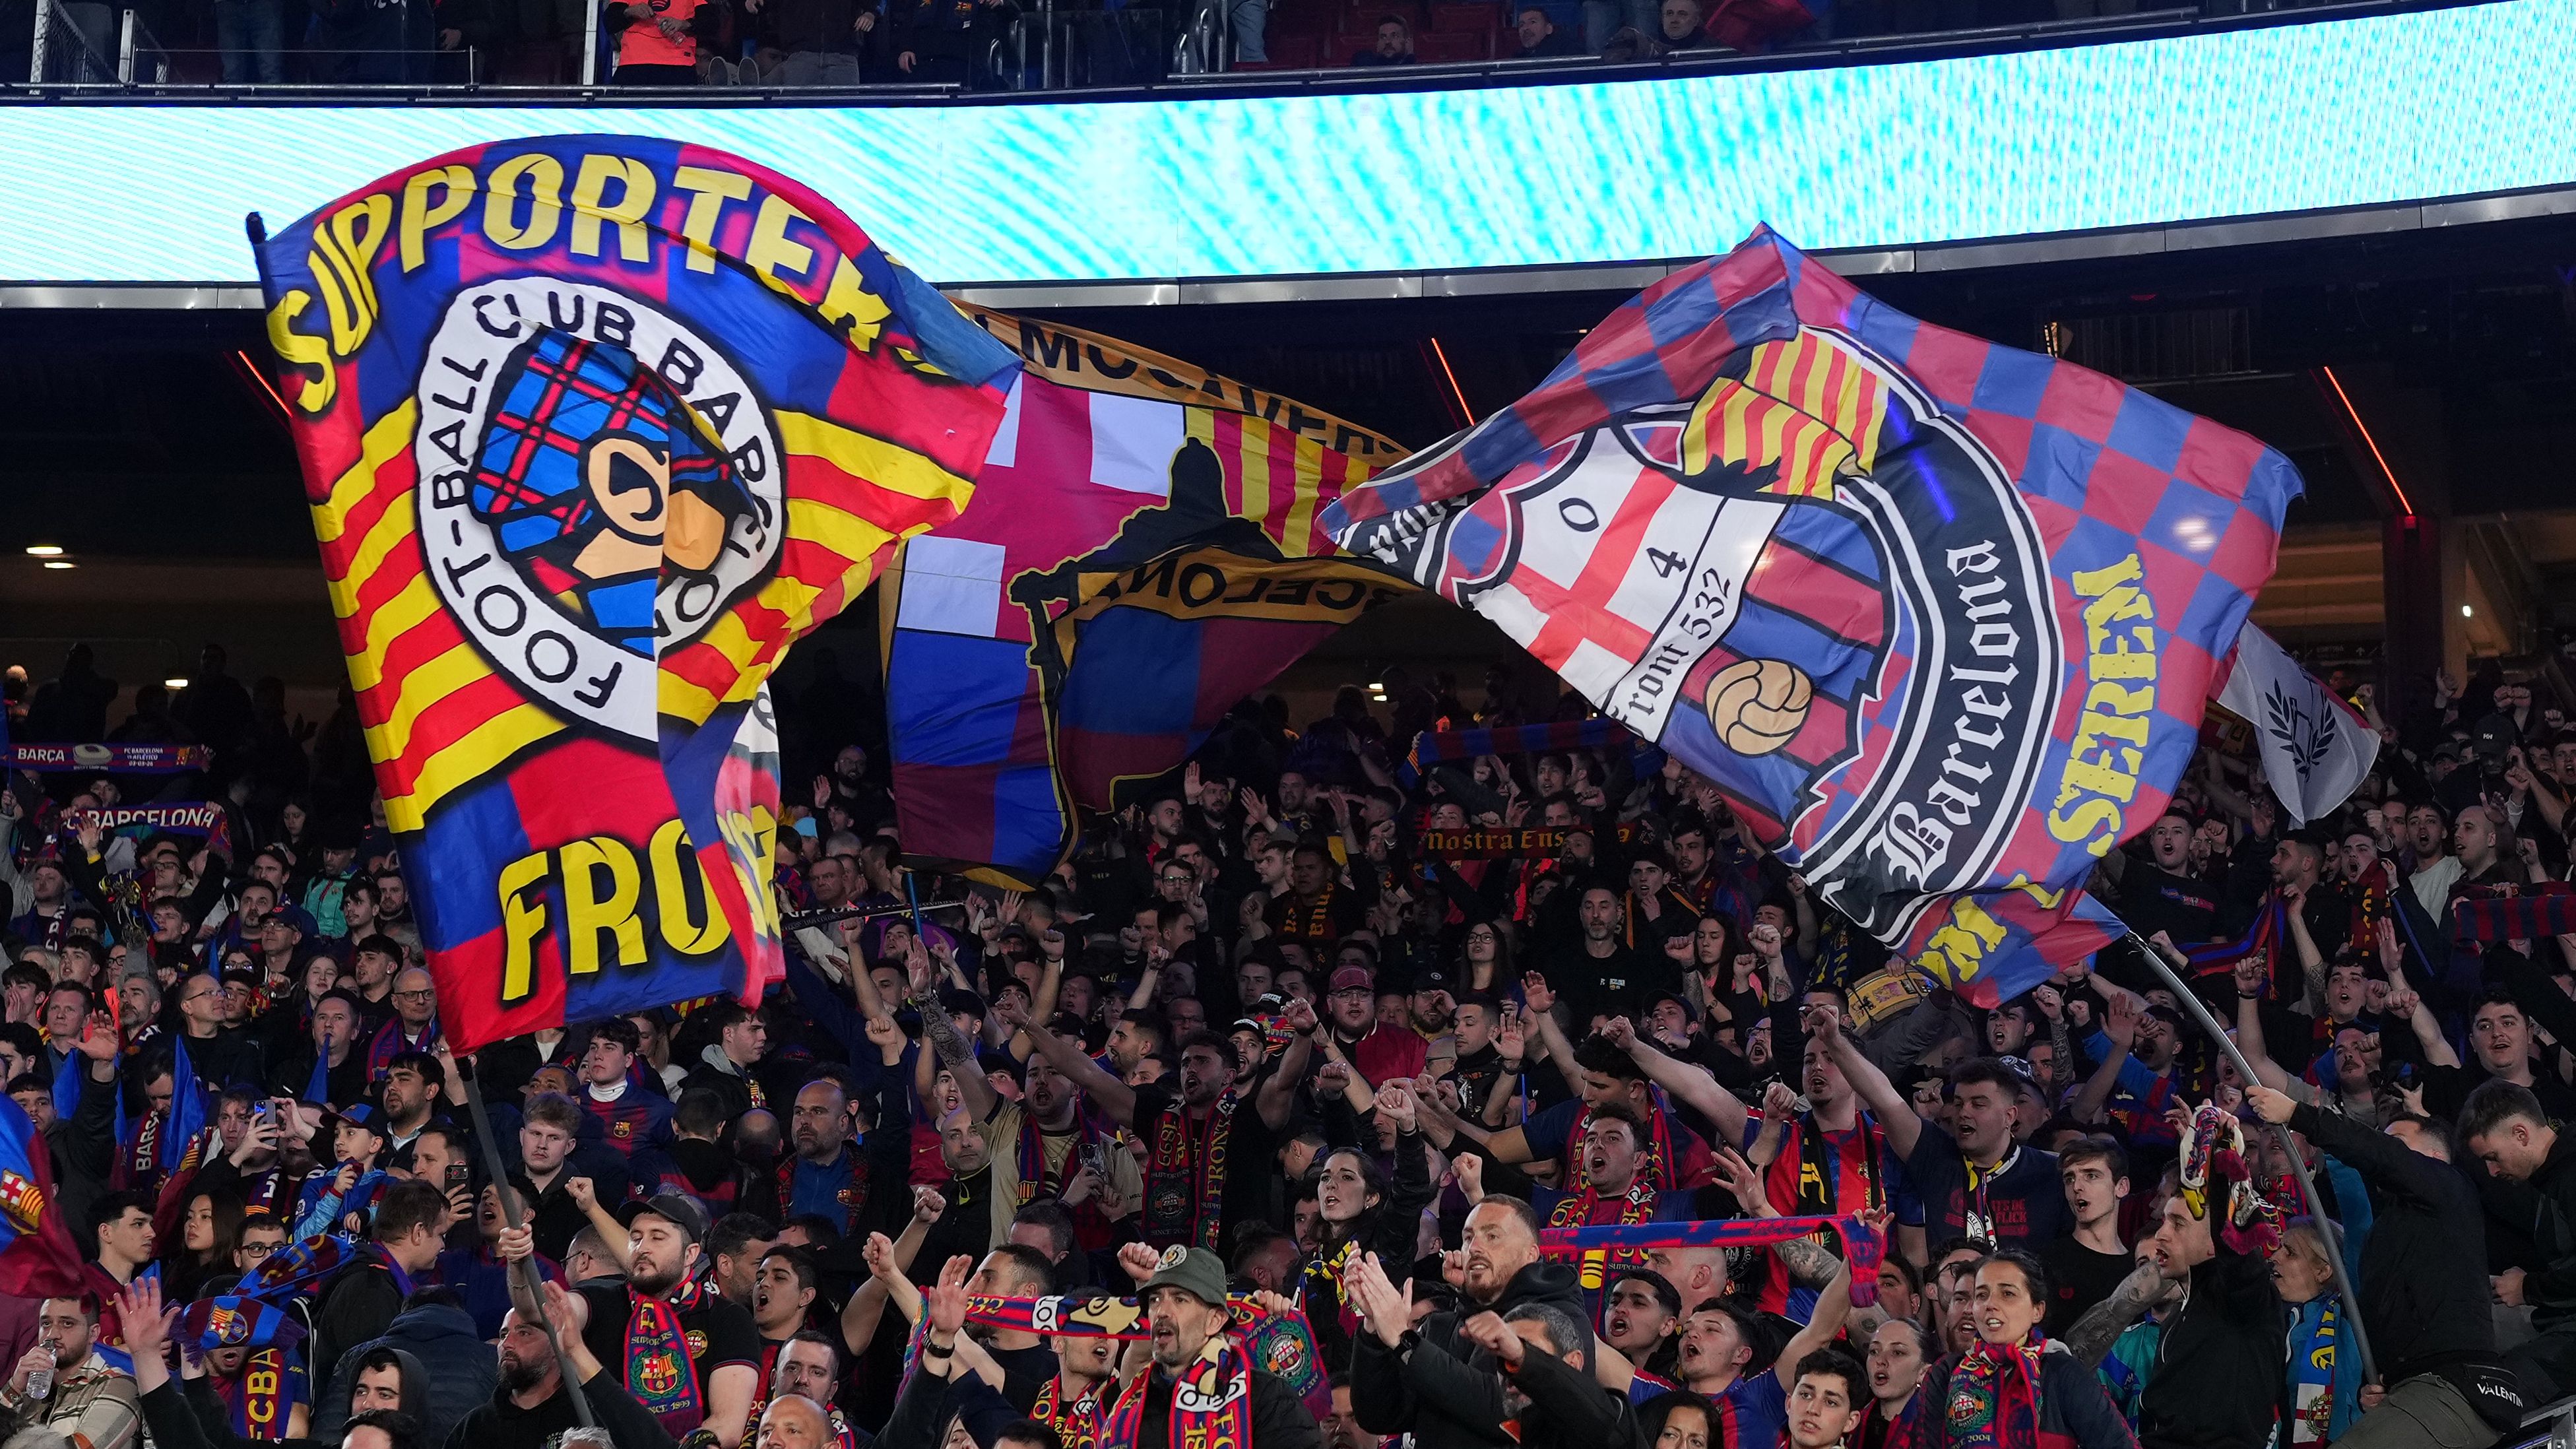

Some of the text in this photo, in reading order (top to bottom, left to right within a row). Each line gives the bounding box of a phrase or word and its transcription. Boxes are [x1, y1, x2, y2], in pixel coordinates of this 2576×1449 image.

[430, 356, 623, 709] FOOT-BALL
[1646, 547, 1687, 578] 4
[1679, 568, 1730, 639] 532
[1865, 539, 2020, 892] Barcelona
[17, 748, 65, 763] BARÇA
[671, 1400, 691, 1410] 1899
